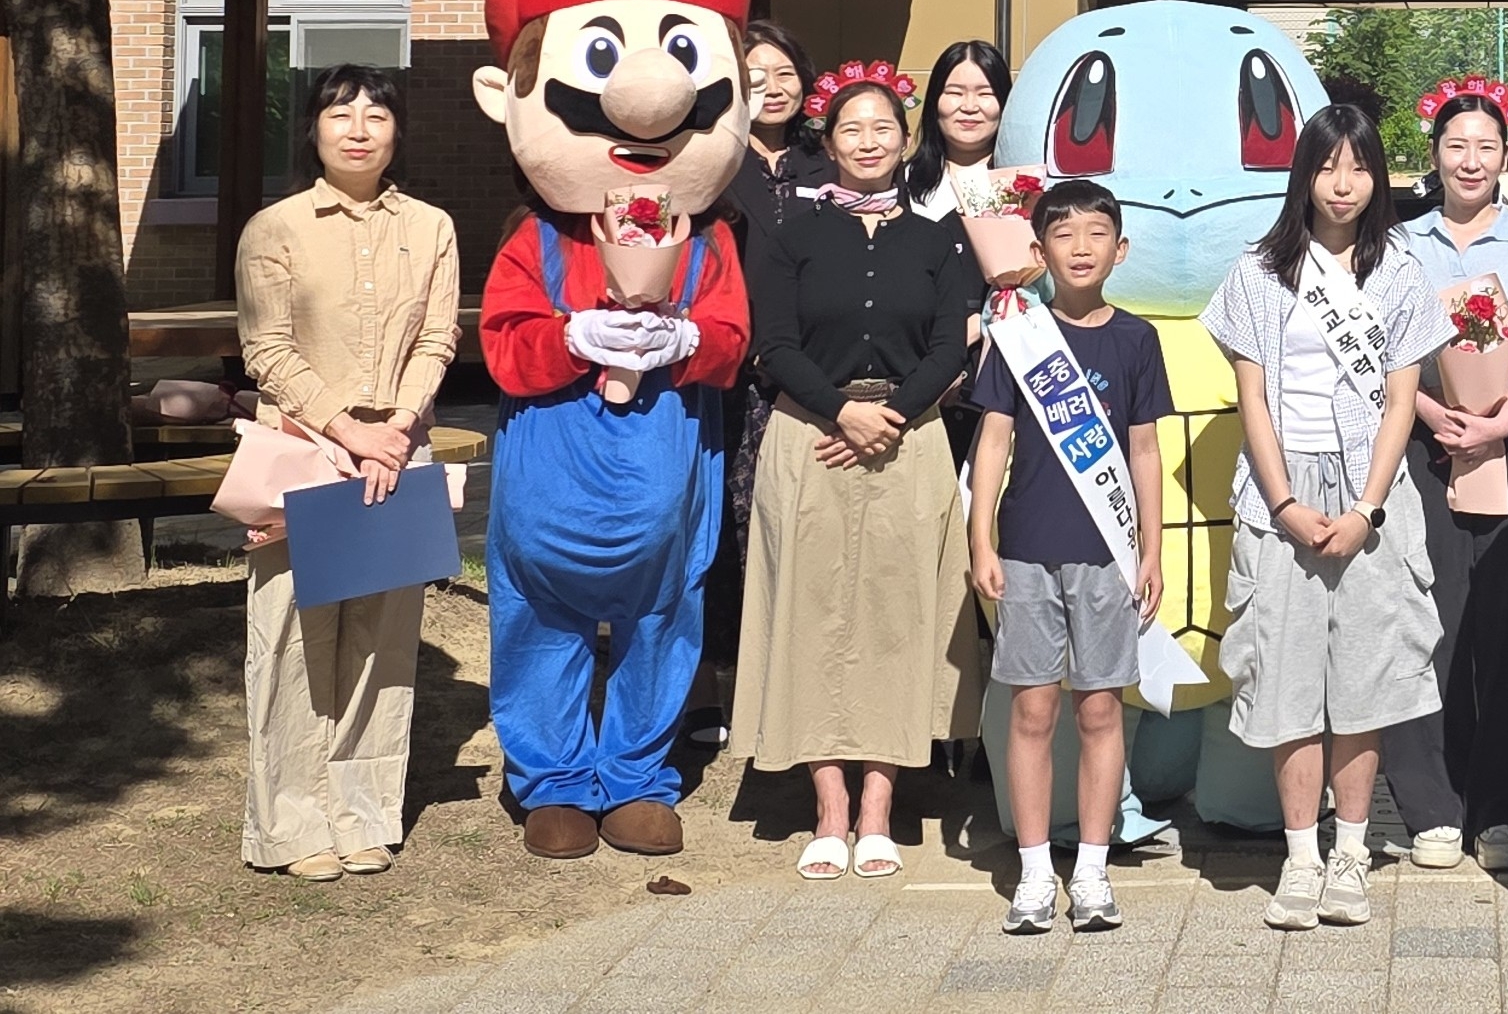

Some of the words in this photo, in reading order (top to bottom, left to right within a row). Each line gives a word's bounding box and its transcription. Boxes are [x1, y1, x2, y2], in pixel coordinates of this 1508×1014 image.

[1303, 285, 1376, 376] 학교폭력
[1029, 356, 1071, 398] 존중
[1046, 392, 1092, 425] 배려
[1068, 424, 1108, 463] 사랑
